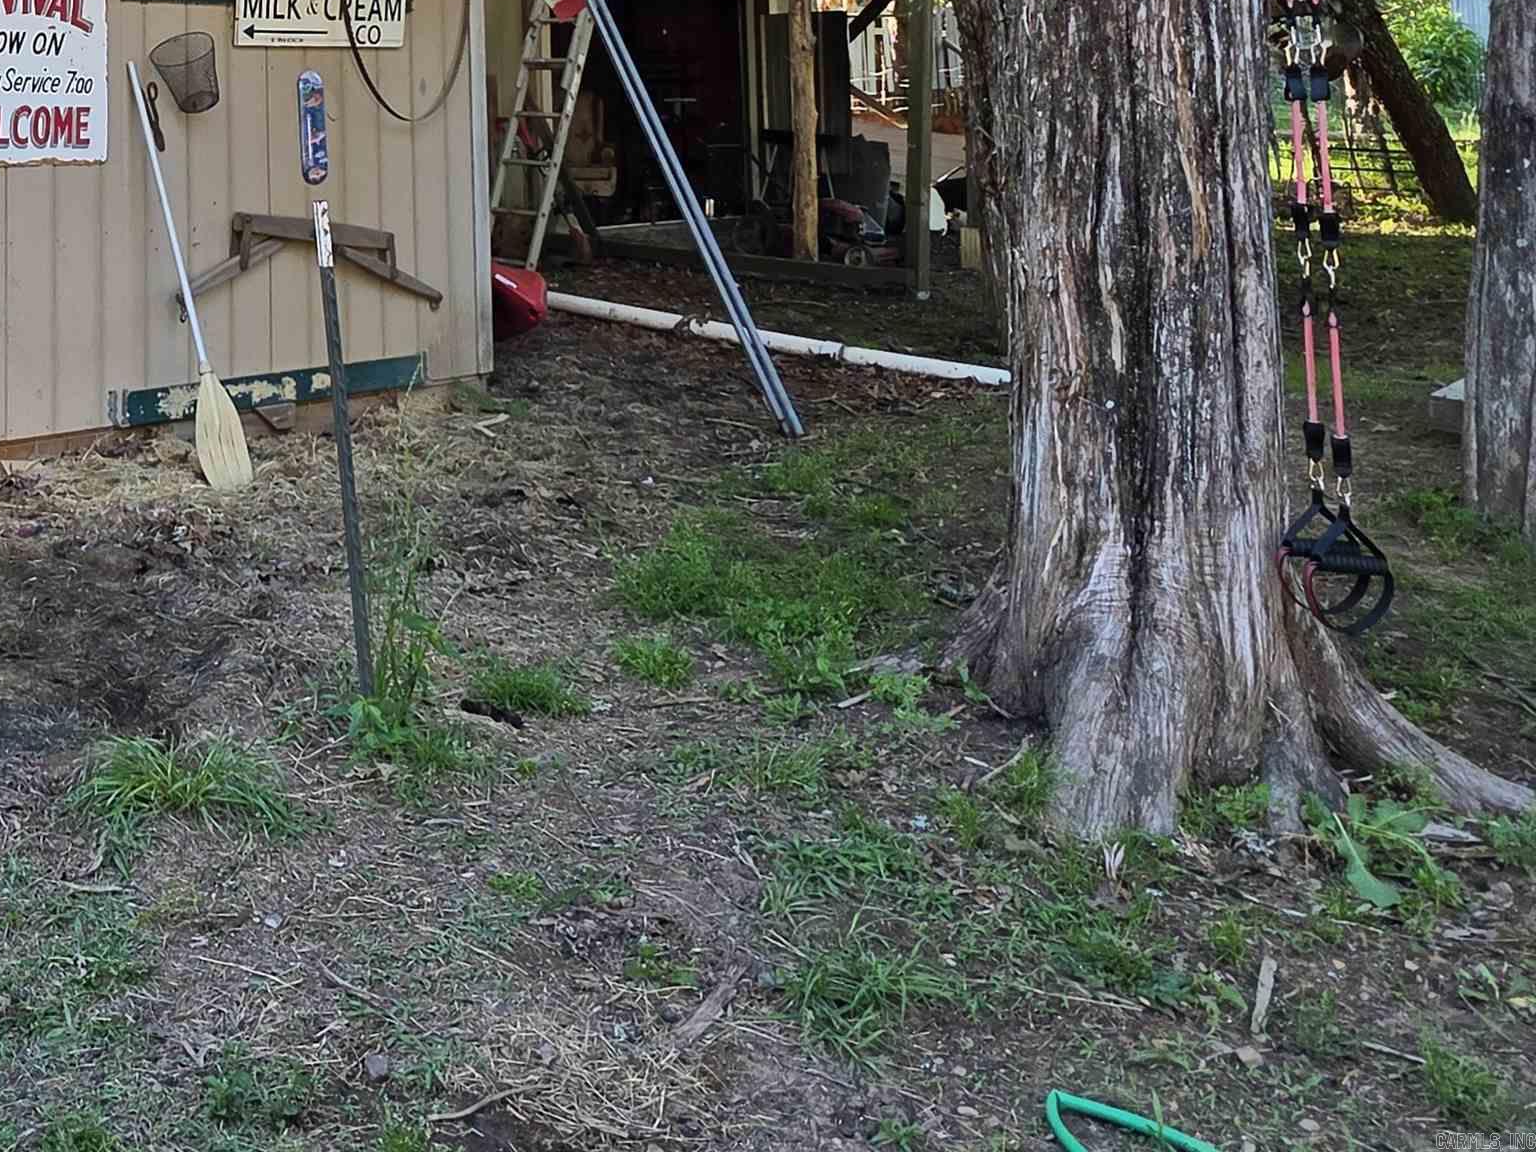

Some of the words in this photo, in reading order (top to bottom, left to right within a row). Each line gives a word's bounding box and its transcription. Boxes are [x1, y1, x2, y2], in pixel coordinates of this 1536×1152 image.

[33, 32, 65, 57] ON
[355, 24, 381, 45] CO
[2, 67, 61, 93] Service
[65, 70, 94, 95] 7:00
